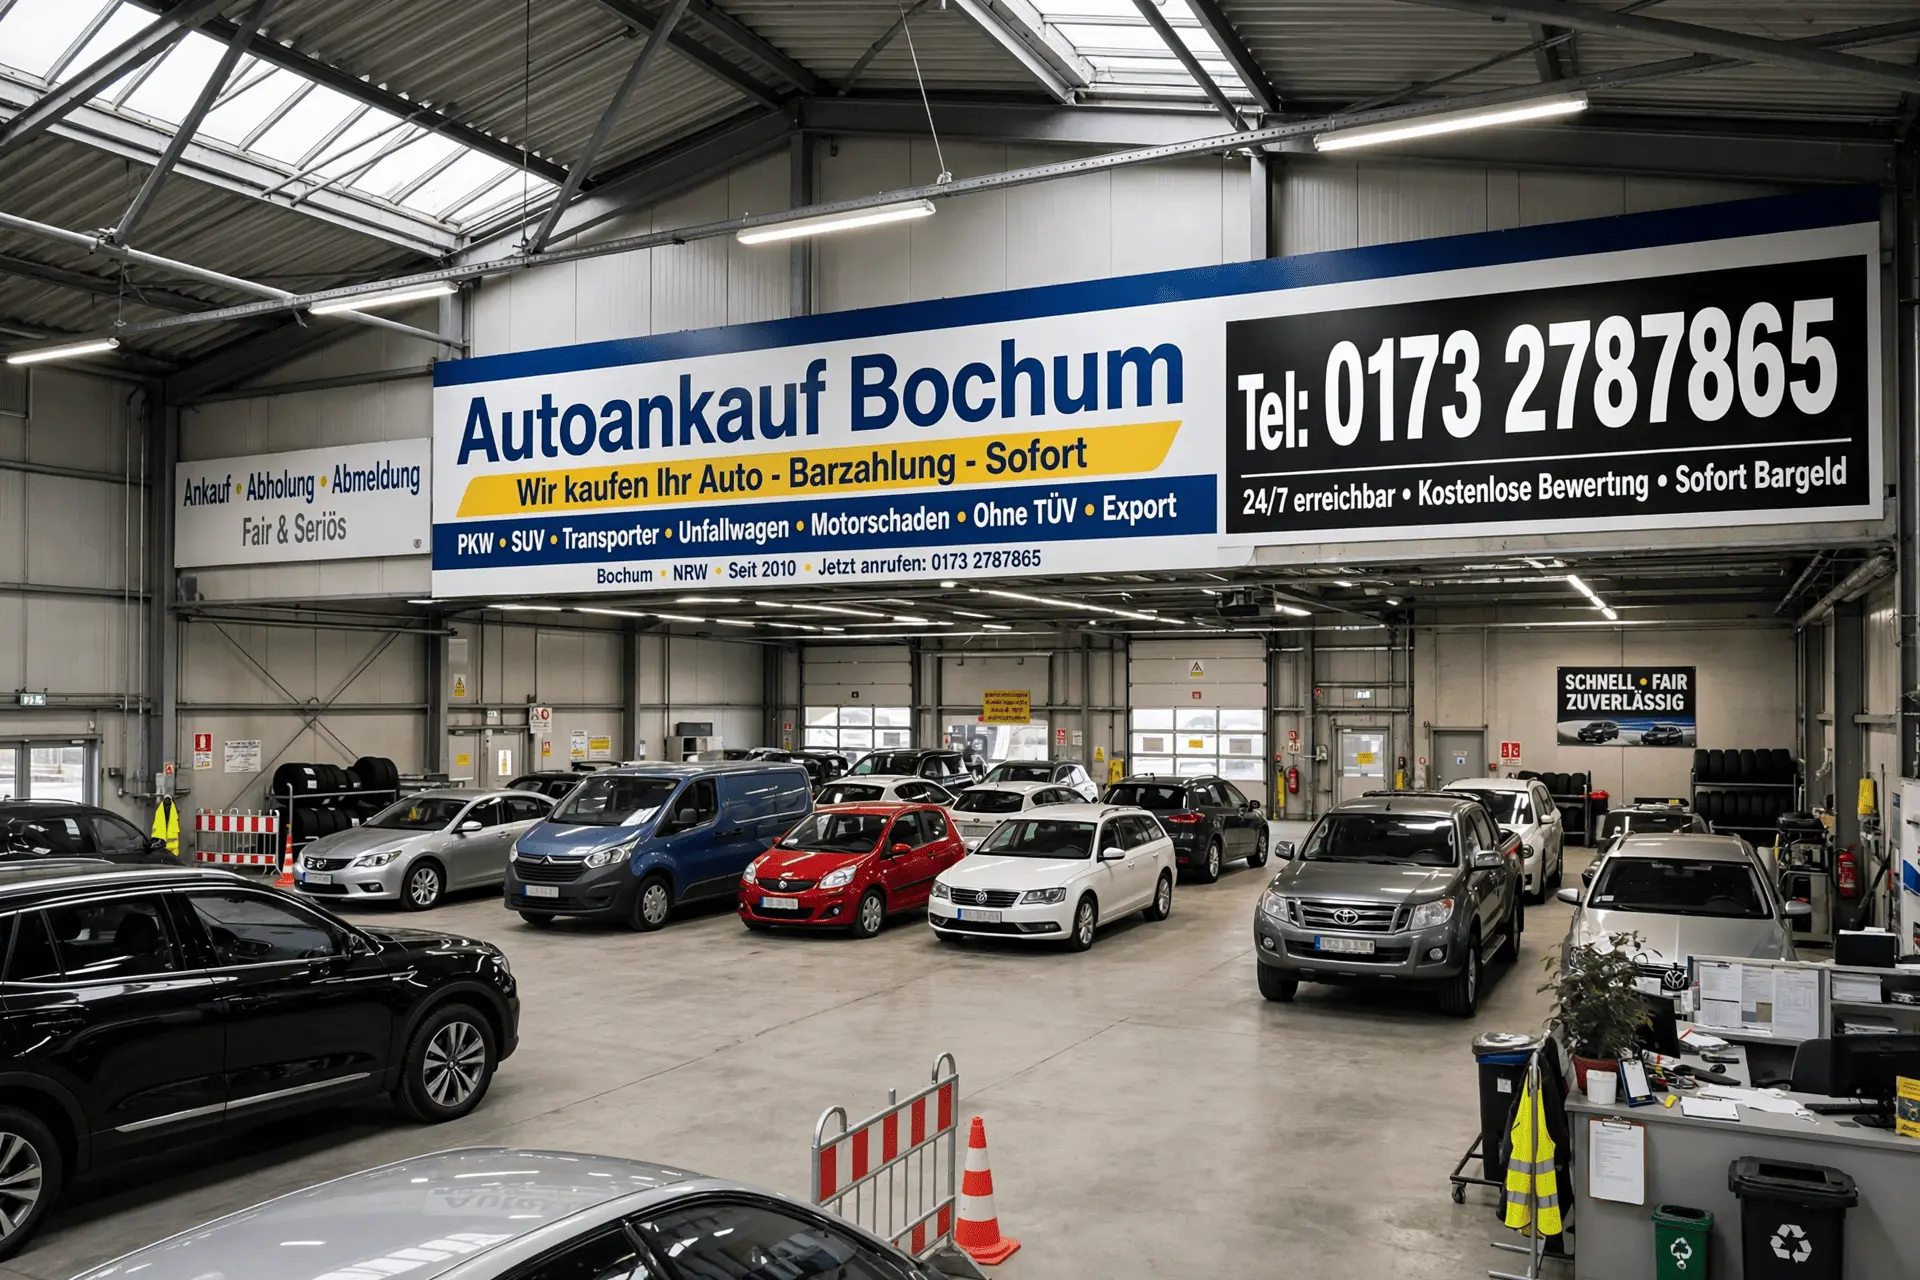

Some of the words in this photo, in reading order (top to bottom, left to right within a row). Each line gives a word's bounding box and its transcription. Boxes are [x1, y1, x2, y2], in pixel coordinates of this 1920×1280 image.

[1238, 371, 1308, 450] Tel:
[1325, 330, 1481, 446] 0173
[1505, 298, 1837, 433] 2787865
[456, 358, 827, 466] Autoankauf
[851, 339, 1183, 431] Bochum
[183, 474, 231, 506] Ankauf
[247, 470, 314, 503] Abholung
[332, 460, 420, 495] Abmeldung
[517, 477, 557, 506] Wir
[565, 471, 648, 503] kaufen
[658, 467, 692, 496] Ihr
[699, 463, 762, 493] Auto
[790, 450, 955, 488] Barzahlung
[986, 437, 1087, 474] Sofort
[1243, 486, 1288, 516] 24/7
[1294, 483, 1395, 512] erreichbar
[1419, 475, 1531, 505] Kostenlose
[1676, 463, 1747, 493] Sofort
[1755, 456, 1846, 494] Bargeld
[243, 516, 272, 546] Fair
[277, 515, 288, 544] &
[295, 511, 346, 543] Seriös
[458, 533, 494, 555] PKW
[512, 529, 545, 552] SUV
[563, 525, 659, 552] Transporter
[680, 518, 788, 545] Unfallwagen
[812, 506, 949, 536] Motorschaden
[974, 502, 1027, 527] Ohne
[1034, 492, 1077, 524] TÜV
[1104, 493, 1176, 526] Export
[598, 567, 652, 583] Bochum
[674, 564, 707, 580] NRW
[729, 562, 757, 578] Seit
[762, 560, 796, 577] 2010
[819, 558, 855, 575] Jetzt
[861, 555, 926, 573] anrufen:
[932, 553, 967, 570] 0173
[973, 550, 1041, 568] 2787865
[1565, 674, 1636, 690] SCHNELL
[1653, 674, 1687, 689] FAIR
[1567, 690, 1684, 710] ZUVERLÄSSIG
